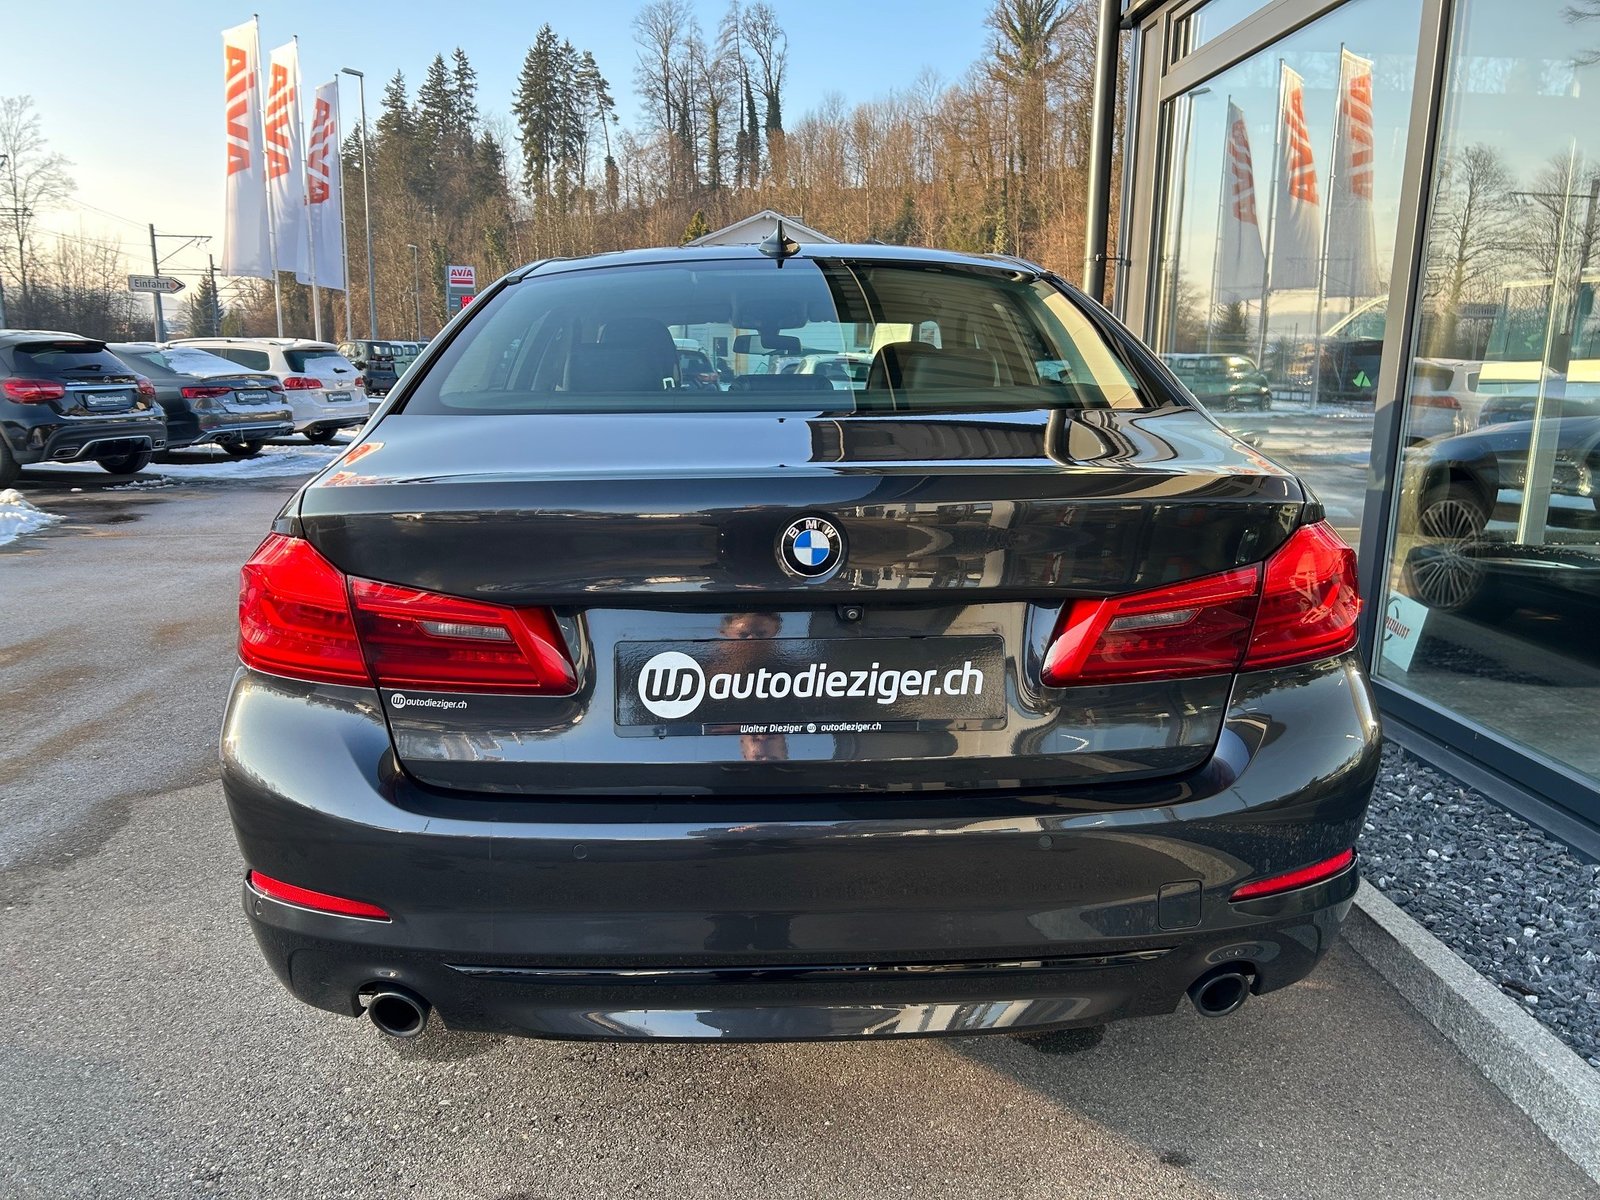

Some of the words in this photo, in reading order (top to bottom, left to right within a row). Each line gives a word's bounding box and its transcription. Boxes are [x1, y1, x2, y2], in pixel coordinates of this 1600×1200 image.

[134, 278, 170, 289] Einfahrt
[787, 519, 837, 540] BMW
[708, 661, 985, 705] autodieziger.ch
[406, 698, 468, 710] autodieziger.ch
[740, 723, 768, 733] Walter
[769, 723, 803, 734] Dieziger
[820, 721, 882, 733] autodieziger.ch
